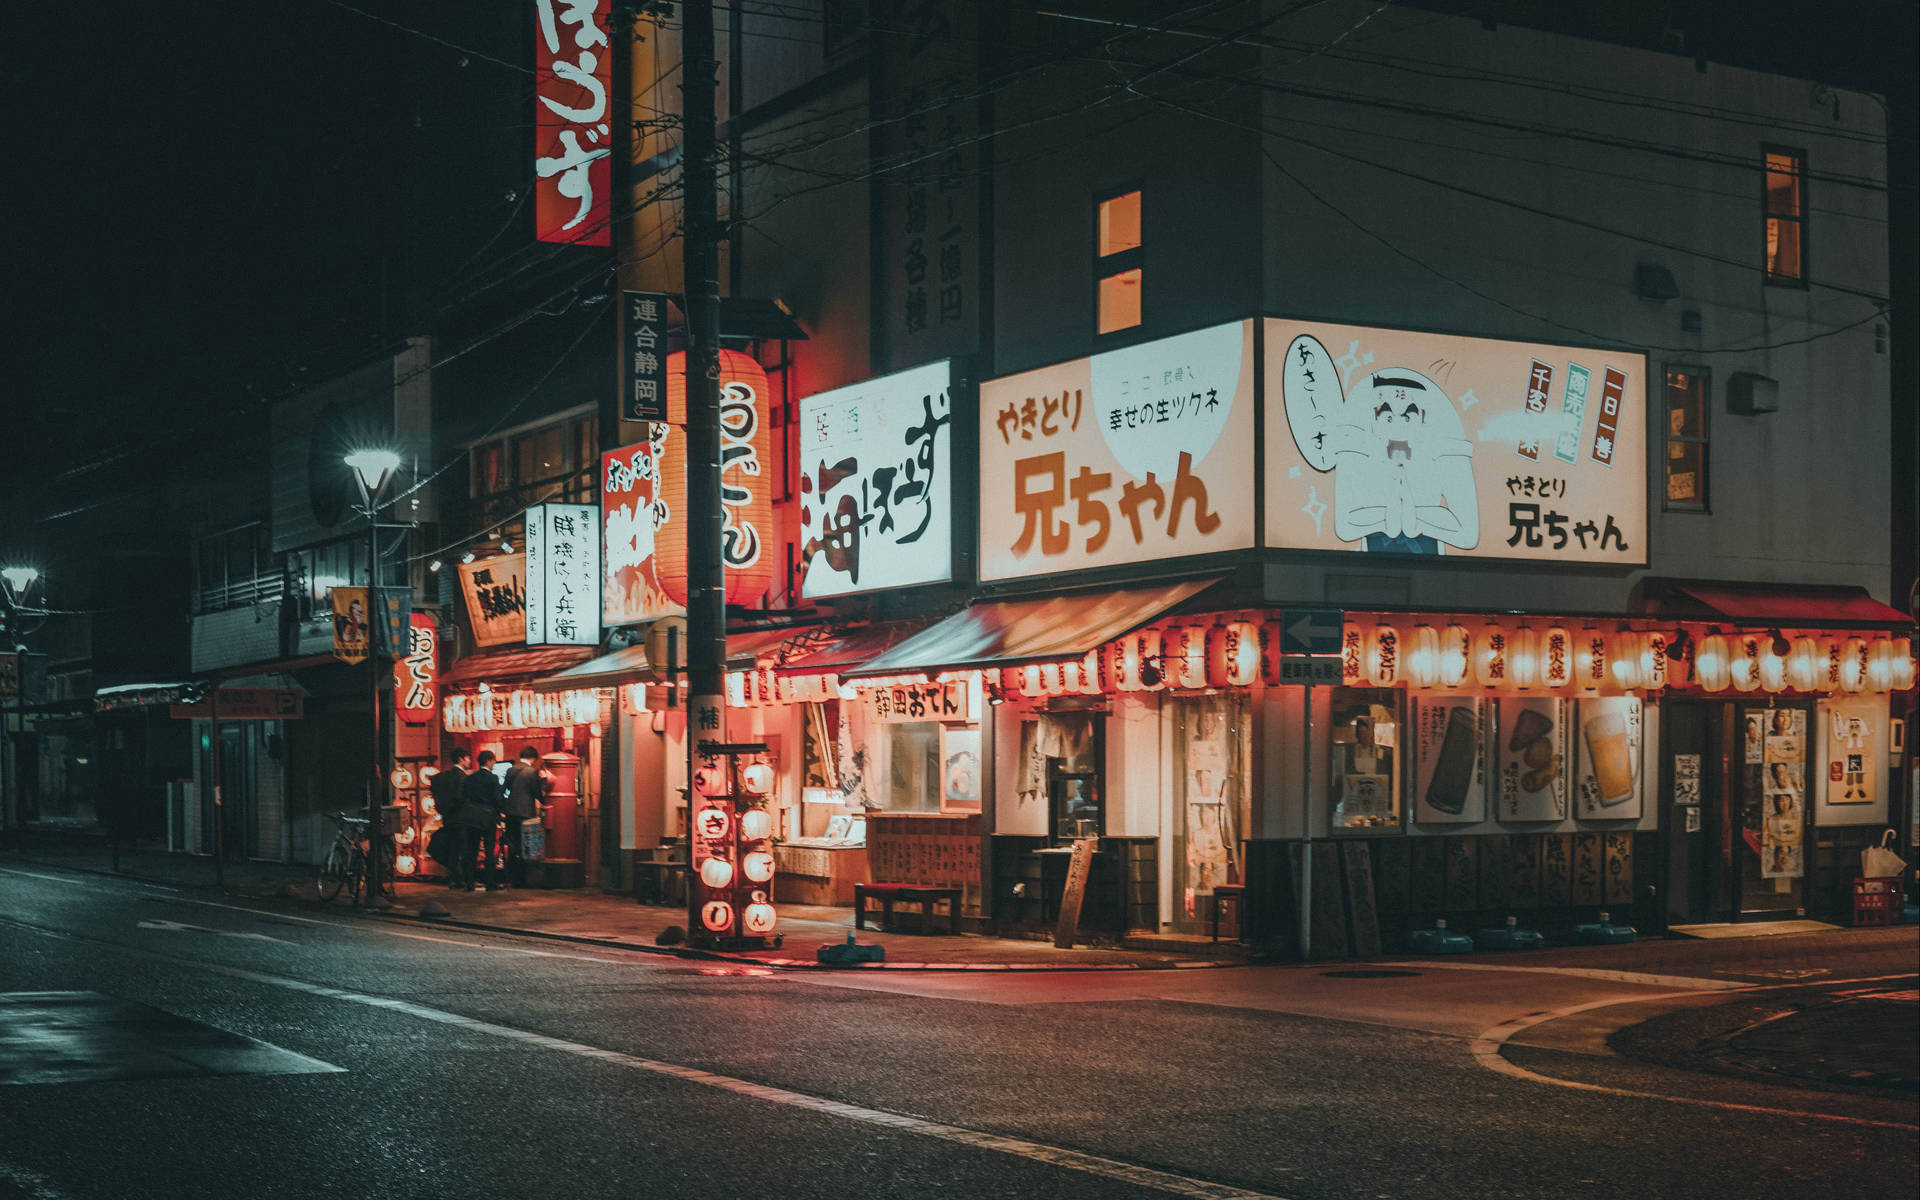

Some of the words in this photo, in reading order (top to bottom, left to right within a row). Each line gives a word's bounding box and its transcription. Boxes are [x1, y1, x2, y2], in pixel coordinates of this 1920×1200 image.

[633, 298, 659, 402] 連合静岡
[996, 388, 1083, 445] やきとり
[1109, 387, 1219, 432] 幸せの生ツクネ
[1517, 367, 1550, 453] 千客来
[1594, 380, 1623, 460] 一日一善
[1010, 450, 1222, 560] 兄ちゃん
[1505, 475, 1567, 500] やきとり
[1506, 501, 1630, 552] 兄ちゃん
[408, 625, 435, 710] おでん
[1378, 632, 1397, 682] やきとり
